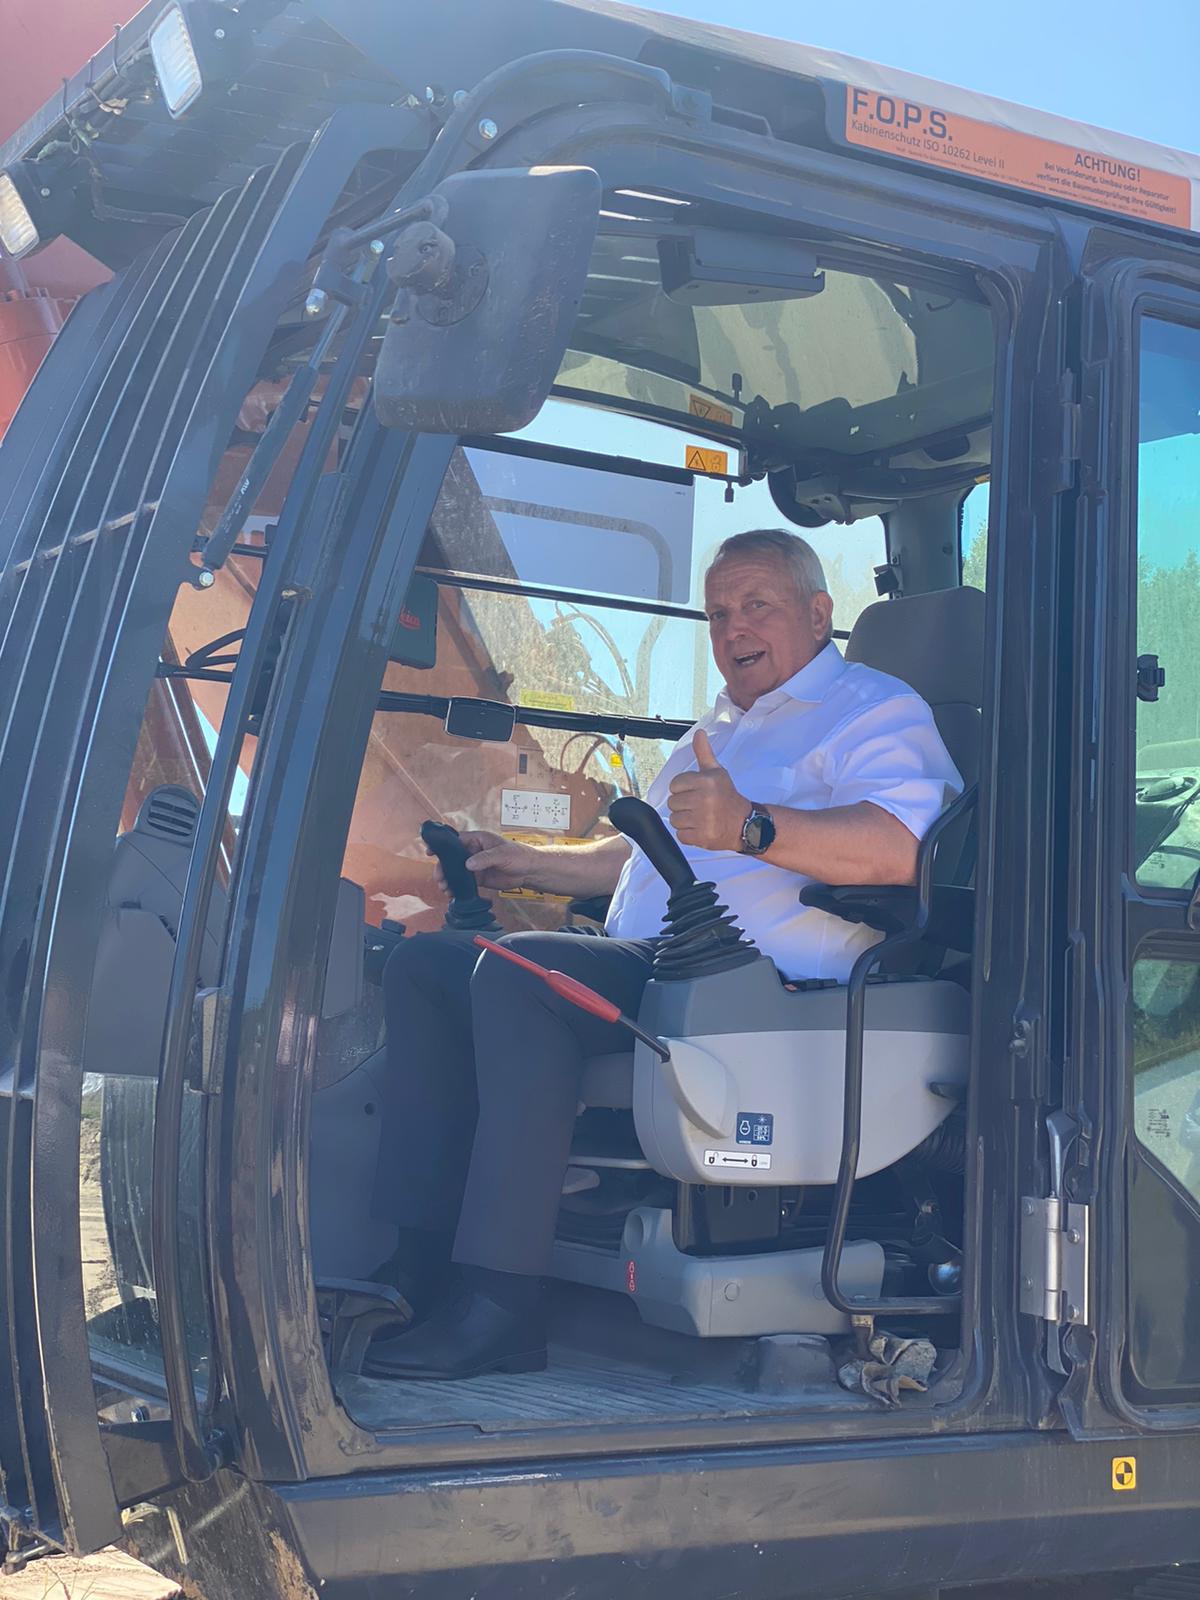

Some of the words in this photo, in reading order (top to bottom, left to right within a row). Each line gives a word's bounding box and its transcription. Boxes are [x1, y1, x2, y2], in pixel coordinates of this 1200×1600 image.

[853, 88, 952, 141] F.O.P.S.
[852, 119, 920, 147] Kabinenschutz
[923, 139, 939, 151] ISO
[943, 144, 970, 160] 10262
[973, 152, 996, 168] Level
[1074, 153, 1141, 182] ACHTUNG!
[1061, 179, 1071, 187] die
[1099, 177, 1121, 189] Umbau
[1123, 184, 1138, 193] oder
[1139, 187, 1169, 200] Reparatur
